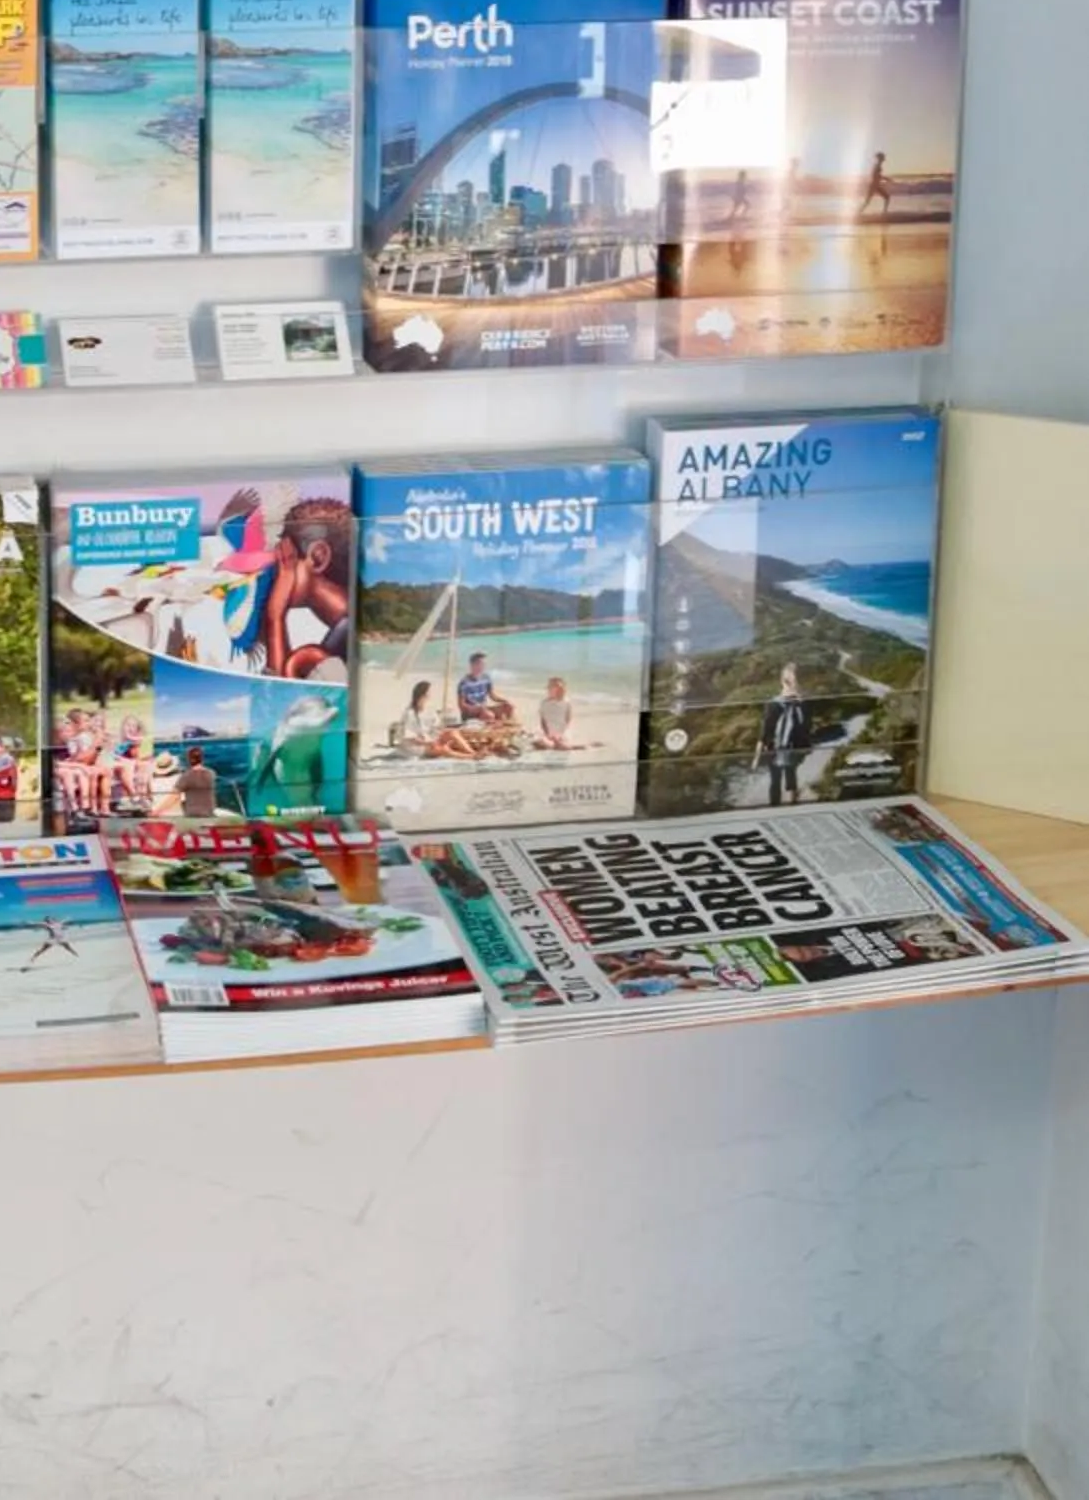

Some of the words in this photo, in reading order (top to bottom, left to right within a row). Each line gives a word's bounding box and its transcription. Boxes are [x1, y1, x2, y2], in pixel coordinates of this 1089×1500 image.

[407, 3, 514, 53] Perth
[708, 0, 827, 27] SUNSET
[677, 437, 833, 475] AMAZING
[676, 470, 813, 507] ALBANY
[76, 504, 195, 529] Bunbury
[404, 502, 502, 542] SOUTH
[512, 497, 600, 537] WEST
[472, 840, 542, 919] Australian
[527, 845, 645, 946] WOMEN
[584, 832, 711, 940] BEATING
[649, 839, 774, 932] BREAST
[711, 829, 834, 923] CANCER
